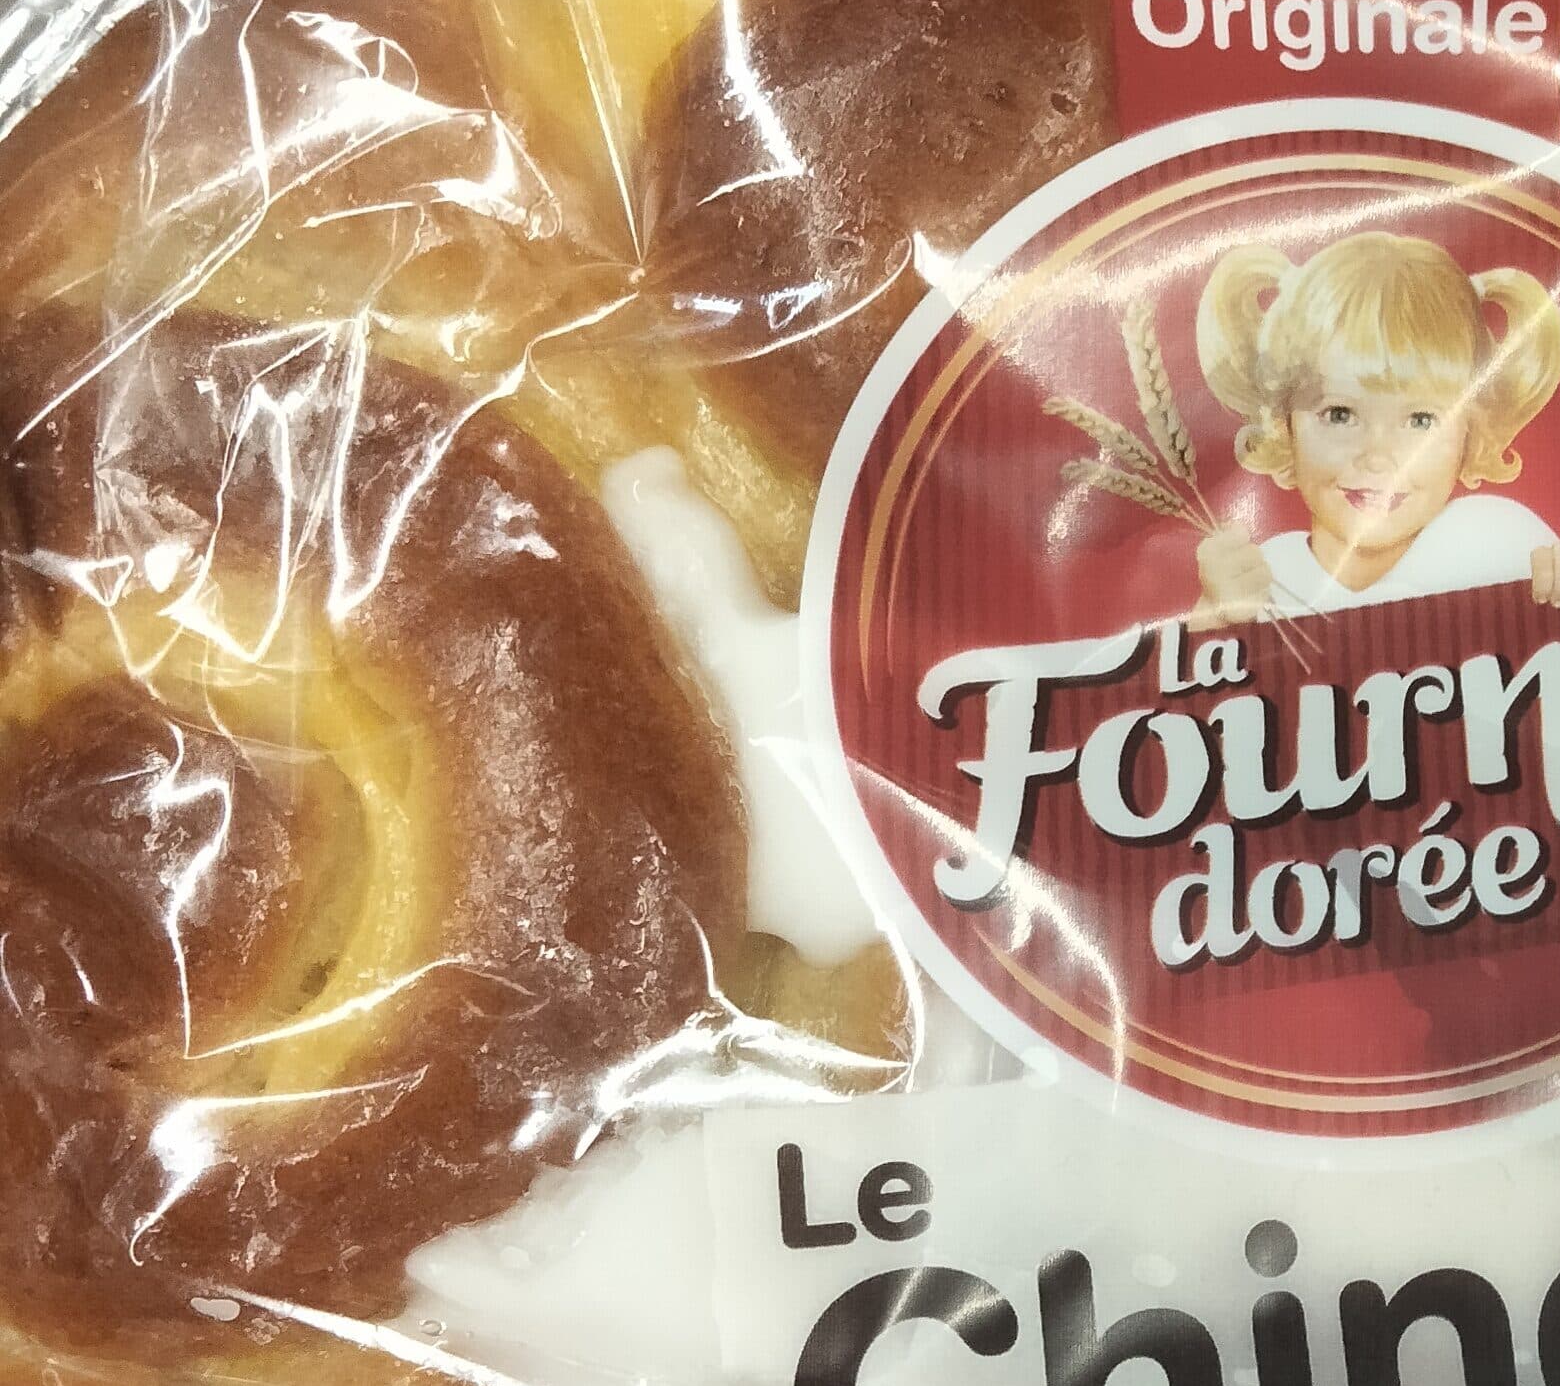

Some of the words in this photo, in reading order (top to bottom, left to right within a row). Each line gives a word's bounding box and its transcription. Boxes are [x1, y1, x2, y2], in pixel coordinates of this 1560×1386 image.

[1158, 622, 1248, 693] la
[1151, 800, 1547, 970] dorée
[776, 1141, 934, 1250] Le
